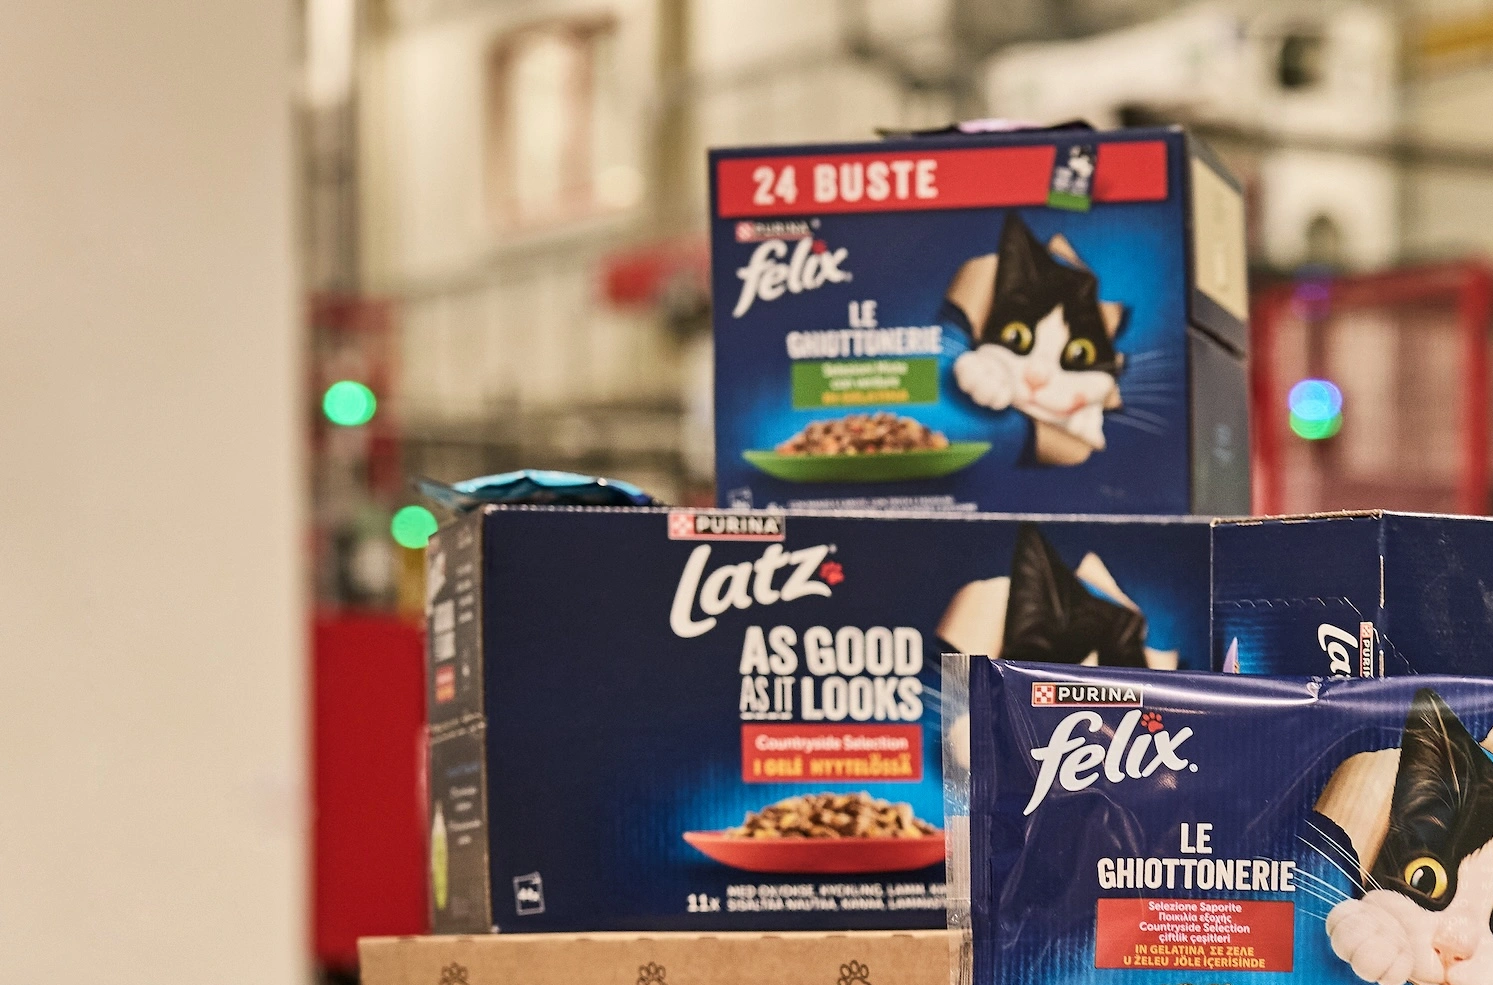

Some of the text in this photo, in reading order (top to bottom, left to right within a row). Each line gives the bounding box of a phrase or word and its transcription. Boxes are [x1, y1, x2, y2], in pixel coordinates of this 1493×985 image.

[752, 159, 940, 206] 24 BUSTE
[732, 236, 849, 318] felix
[848, 300, 877, 327] LE
[695, 515, 780, 534] PURINA
[670, 544, 832, 638] Latz
[740, 626, 923, 676] AS GOOD
[740, 675, 923, 721] AS IT LOOKS
[1058, 686, 1137, 702] PURINA
[755, 734, 909, 754] Countryside Selection
[1023, 709, 1194, 816] felix
[1180, 823, 1213, 854] LE
[1097, 858, 1296, 892] GHIOTTONERIE
[687, 893, 720, 913] 11x
[1148, 901, 1242, 914] Selezione Saporite
[1139, 921, 1250, 935] Countryside Selection
[1159, 932, 1188, 944] çiftlik
[1123, 956, 1131, 965] U
[1174, 955, 1201, 967] JÖLE
[1135, 944, 1205, 956] IN GELATINA
